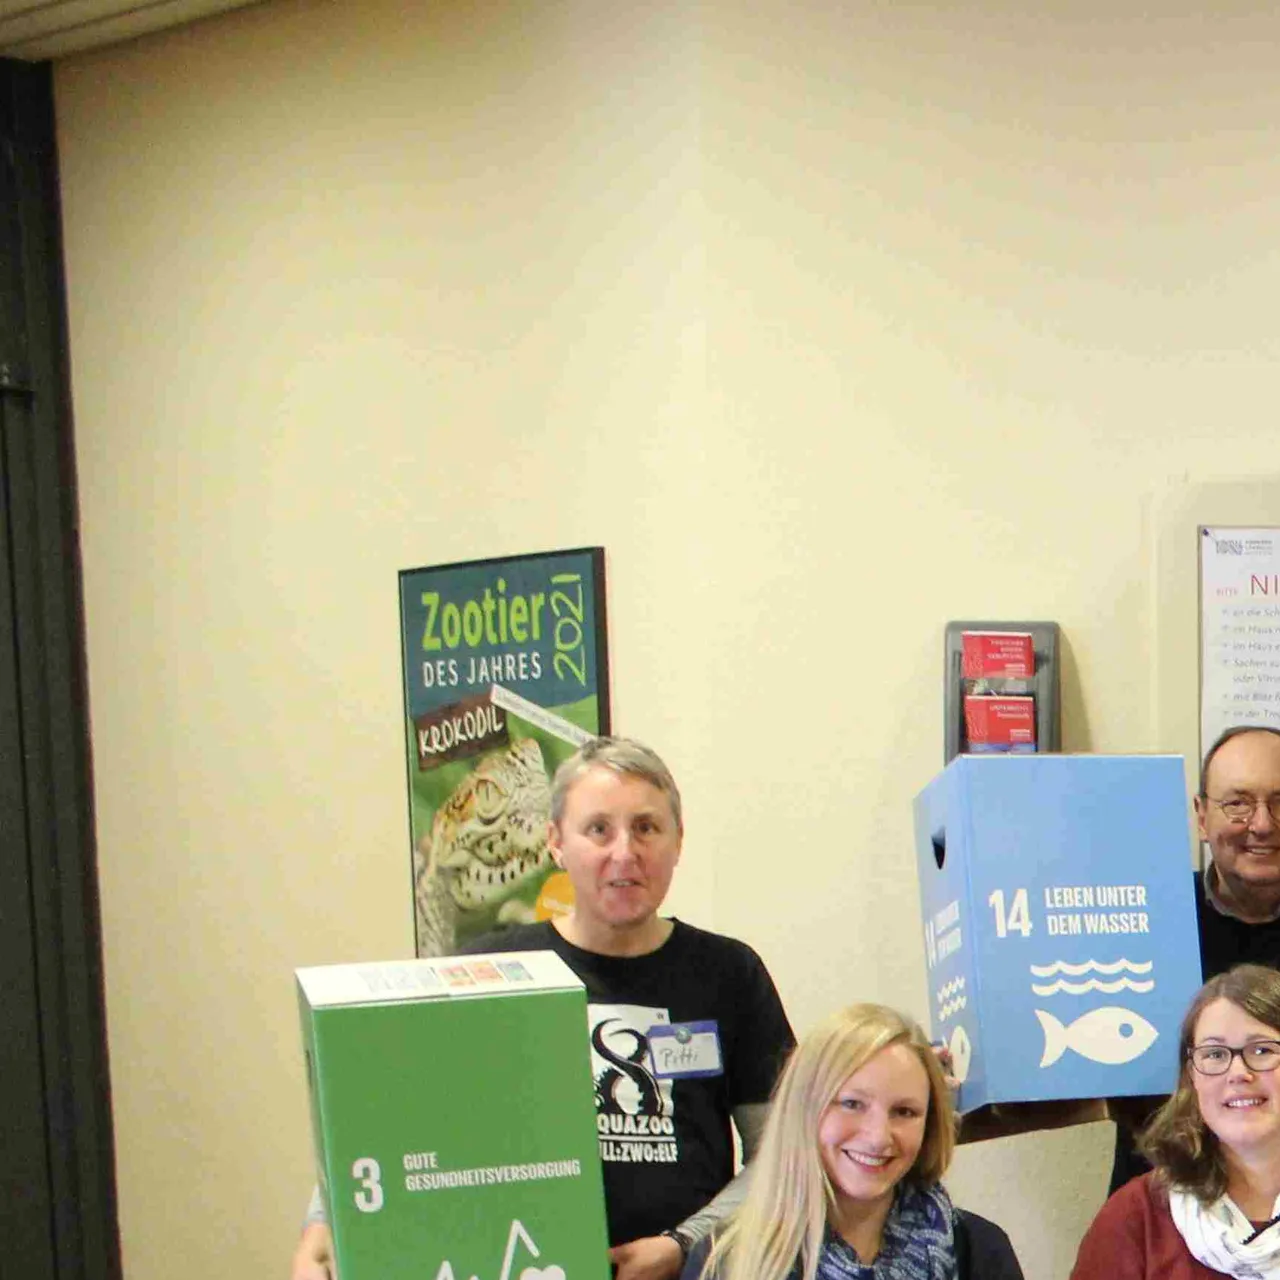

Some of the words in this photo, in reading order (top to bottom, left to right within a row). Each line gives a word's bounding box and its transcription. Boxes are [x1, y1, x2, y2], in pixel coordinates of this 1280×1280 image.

[421, 577, 545, 652] Zootier
[550, 572, 586, 687] 2021
[422, 658, 459, 688] DES
[466, 652, 542, 685] JAHRES
[418, 705, 504, 758] KROKODIL
[989, 888, 1033, 939] 14
[1044, 887, 1094, 909] LEBEN
[1096, 885, 1147, 907] UNTER
[1047, 914, 1082, 936] DEM
[1083, 912, 1150, 935] WASSER
[352, 1157, 383, 1213] 3
[403, 1152, 438, 1171] GUTE
[405, 1159, 581, 1192] GESUNDHEITSVERSORGUNG
